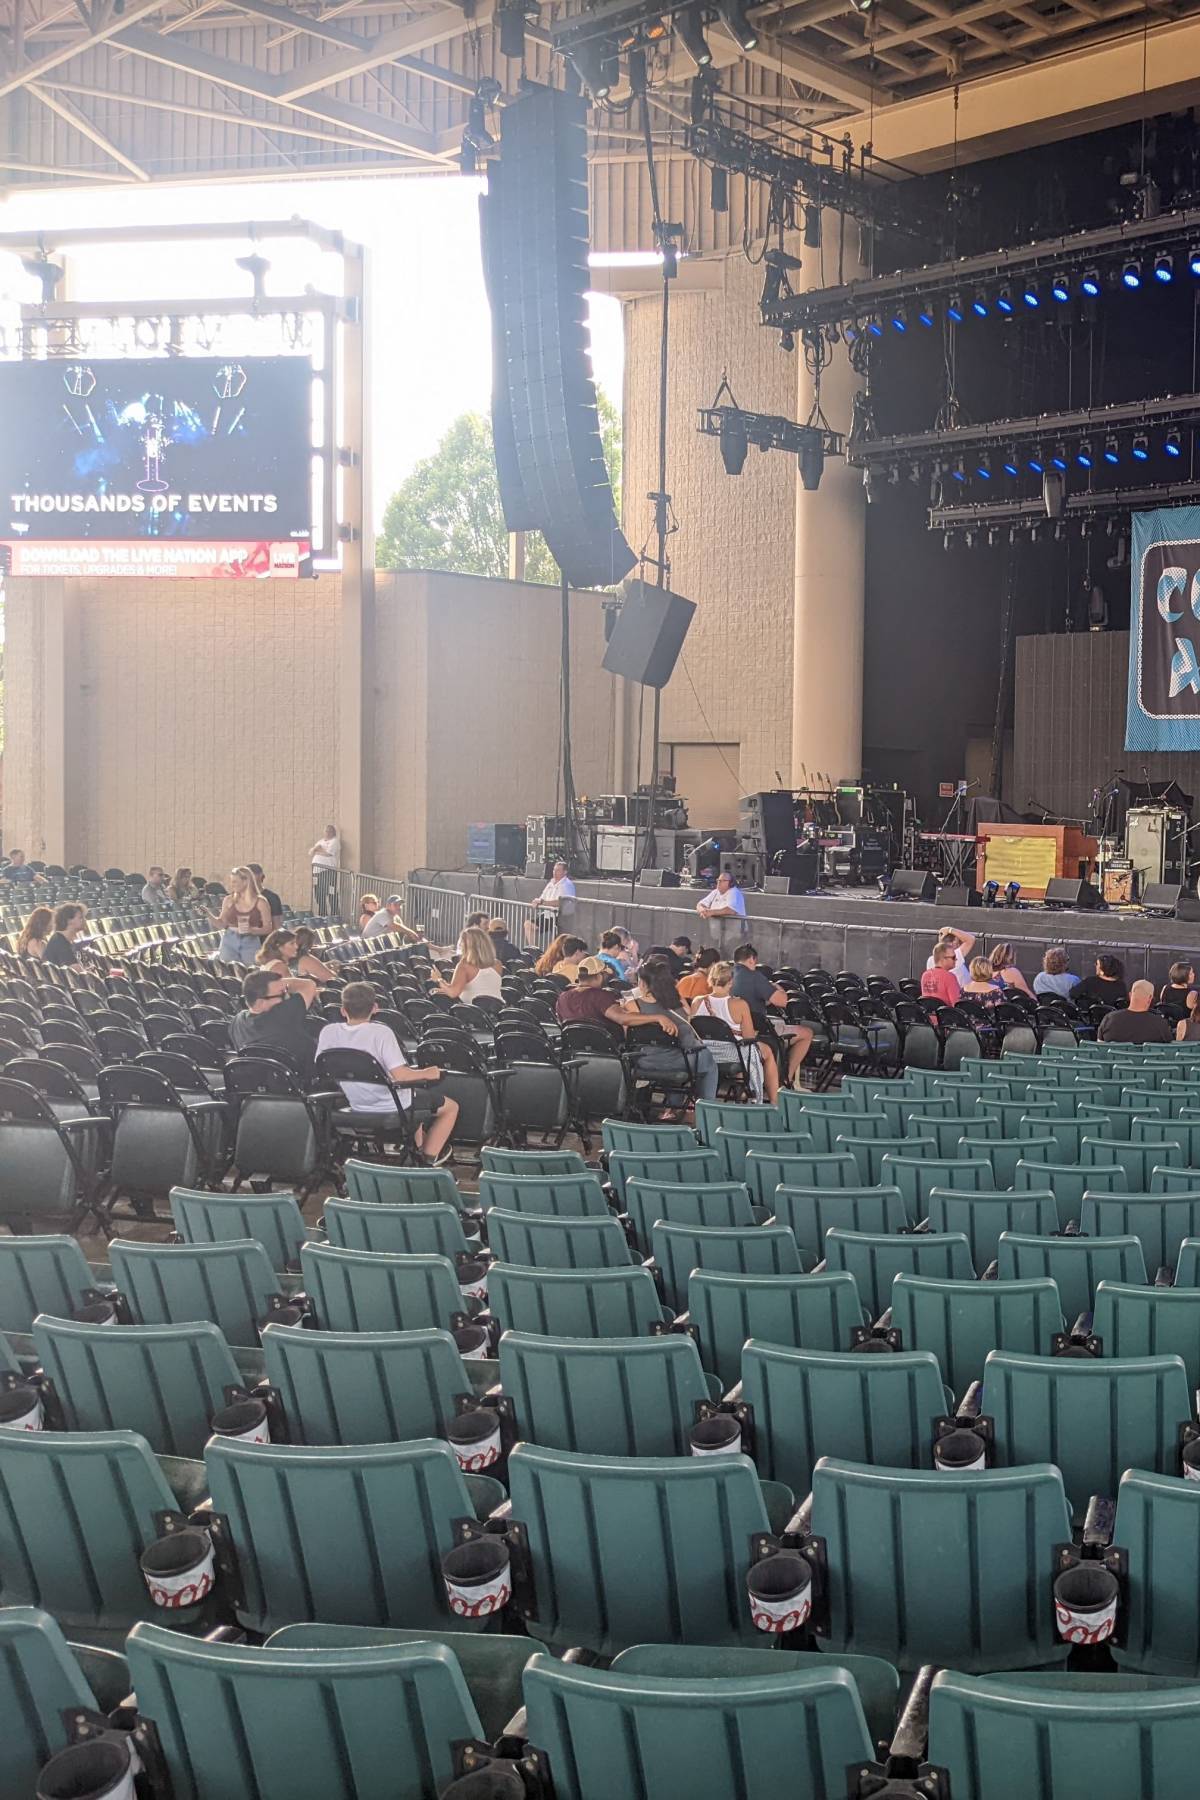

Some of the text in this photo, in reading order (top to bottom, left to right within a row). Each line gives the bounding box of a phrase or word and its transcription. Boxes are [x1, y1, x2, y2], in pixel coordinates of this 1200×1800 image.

[11, 495, 278, 512] THOUSANDS OF EVENTS
[21, 548, 248, 563] DOWNLOAD THE LIVE NATION APP
